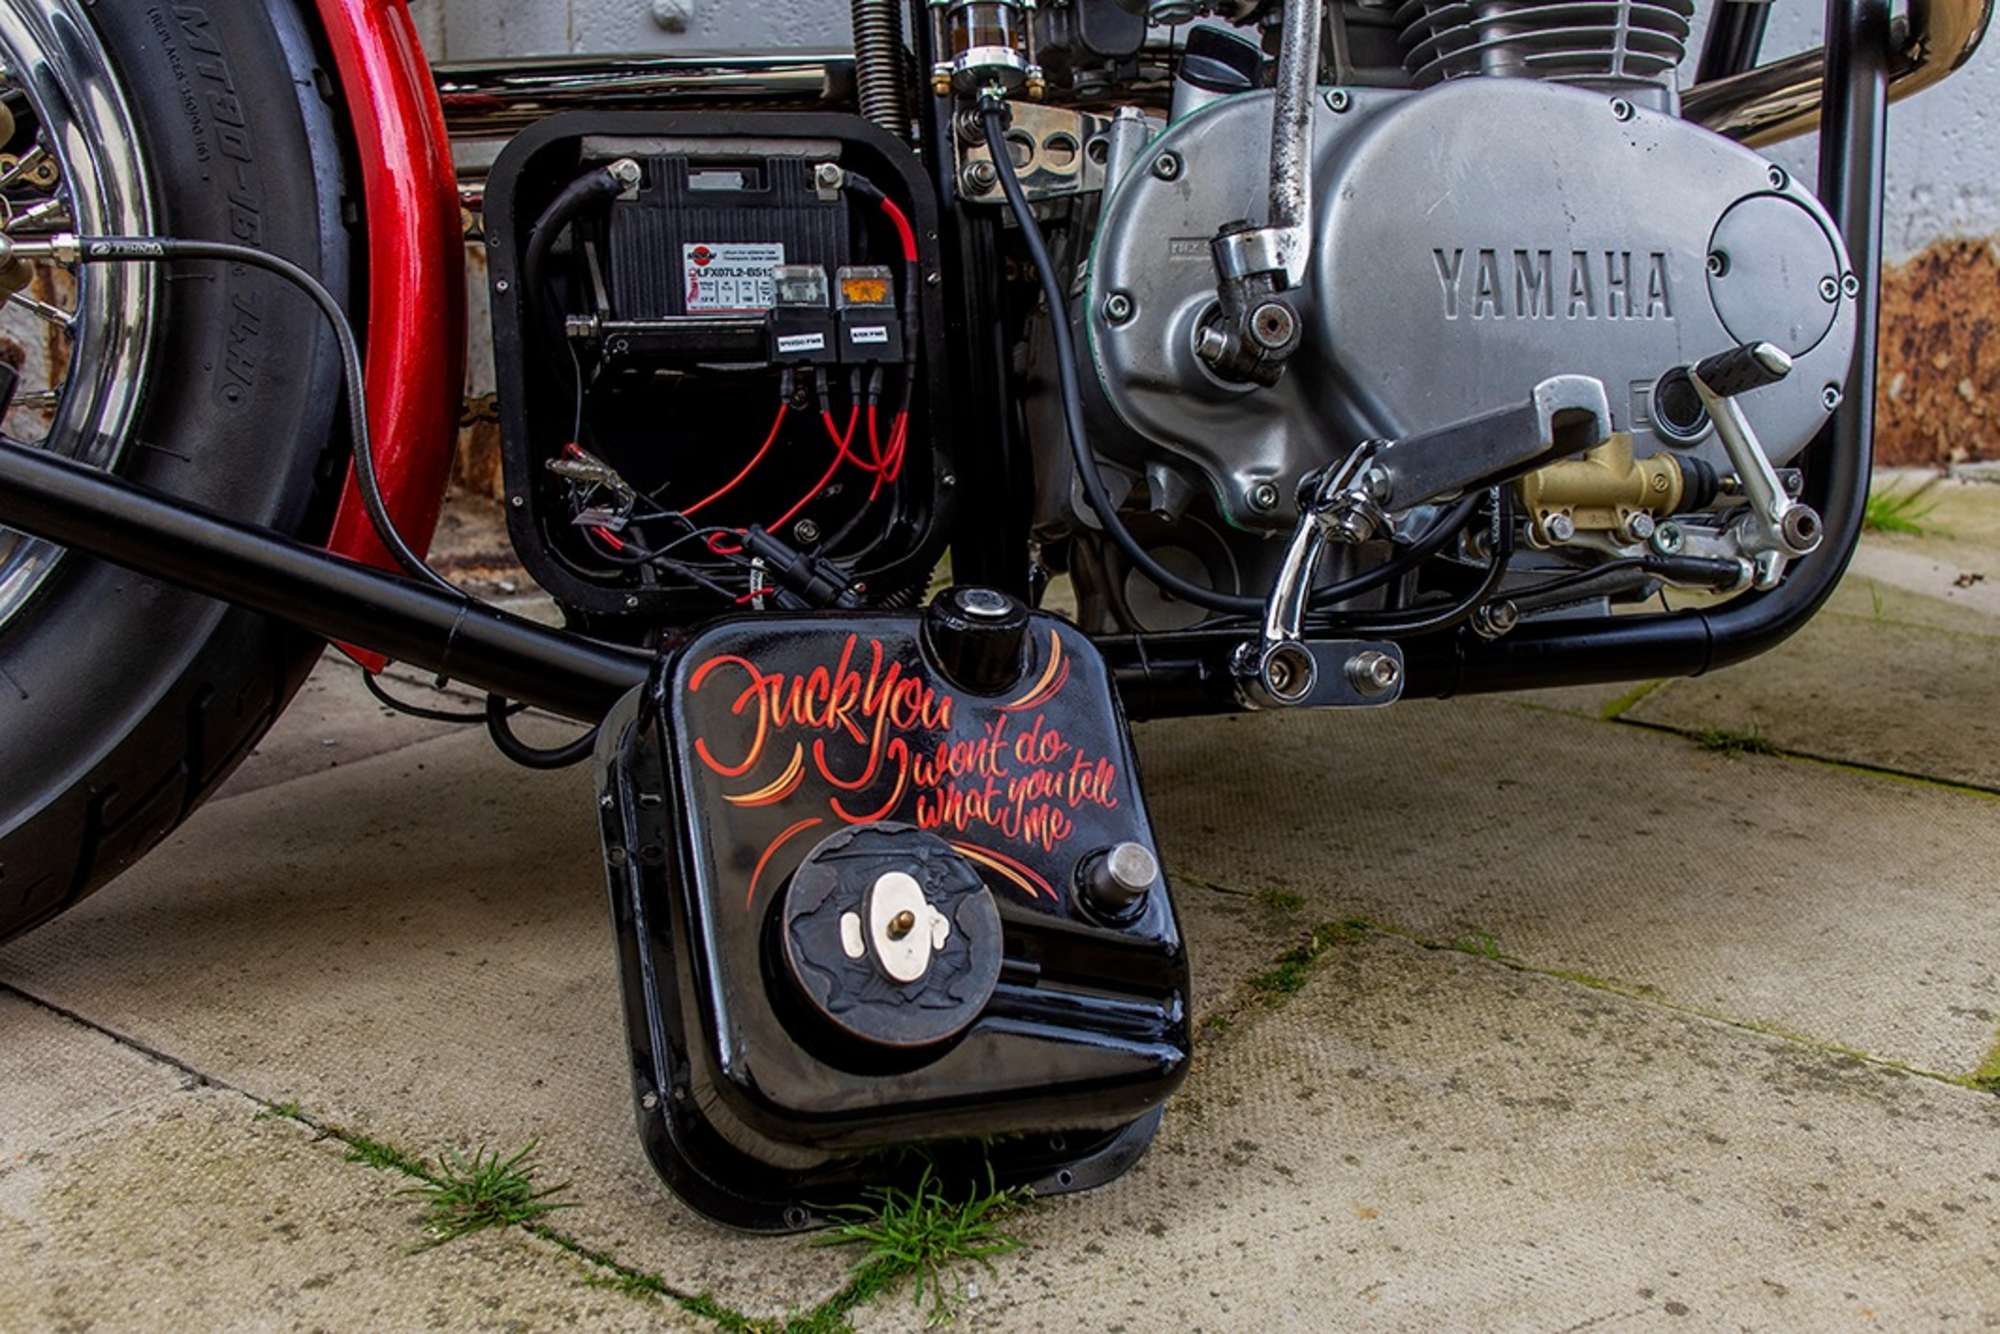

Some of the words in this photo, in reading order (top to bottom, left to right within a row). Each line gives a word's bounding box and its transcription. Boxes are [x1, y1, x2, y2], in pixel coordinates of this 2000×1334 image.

[1431, 248, 1675, 320] YAMAHA
[813, 639, 953, 790] You
[914, 714, 1009, 787] won't
[1015, 713, 1072, 765] do
[916, 775, 1003, 834] what
[1000, 766, 1065, 838] you
[1066, 748, 1118, 809] tell
[1023, 803, 1072, 852] me
